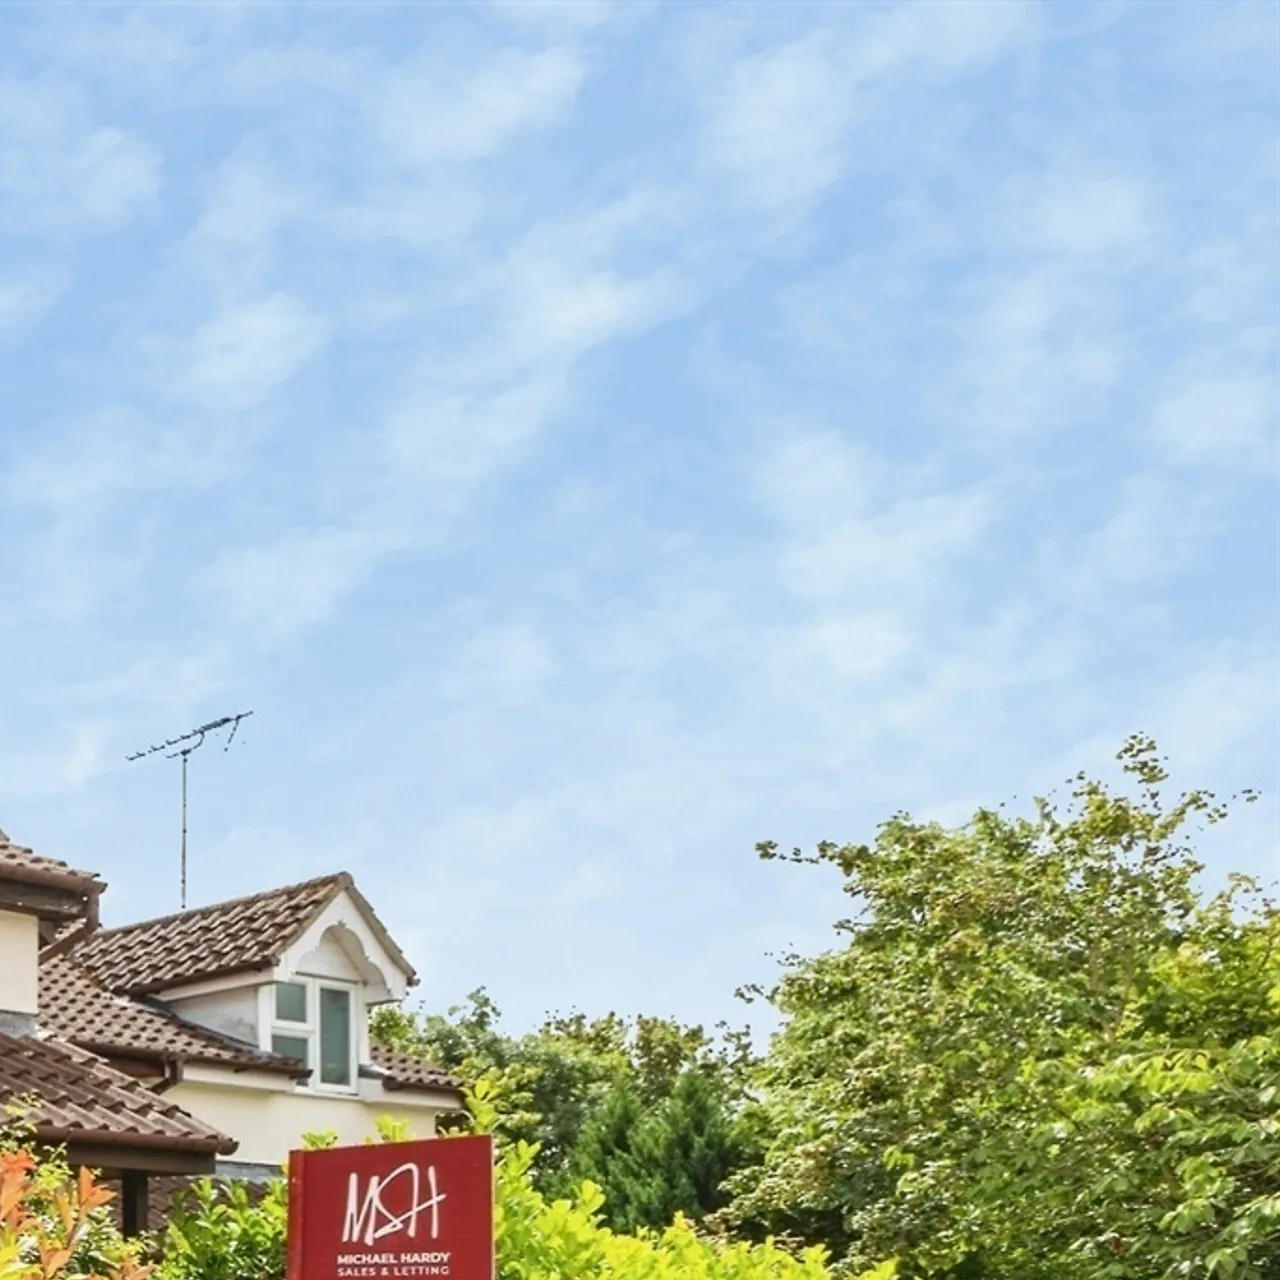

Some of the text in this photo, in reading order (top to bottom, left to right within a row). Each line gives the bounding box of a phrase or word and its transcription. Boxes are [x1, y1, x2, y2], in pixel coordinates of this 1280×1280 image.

[337, 1252, 451, 1265] MICHAEL HARDY
[337, 1265, 450, 1277] SALES & LETTING
